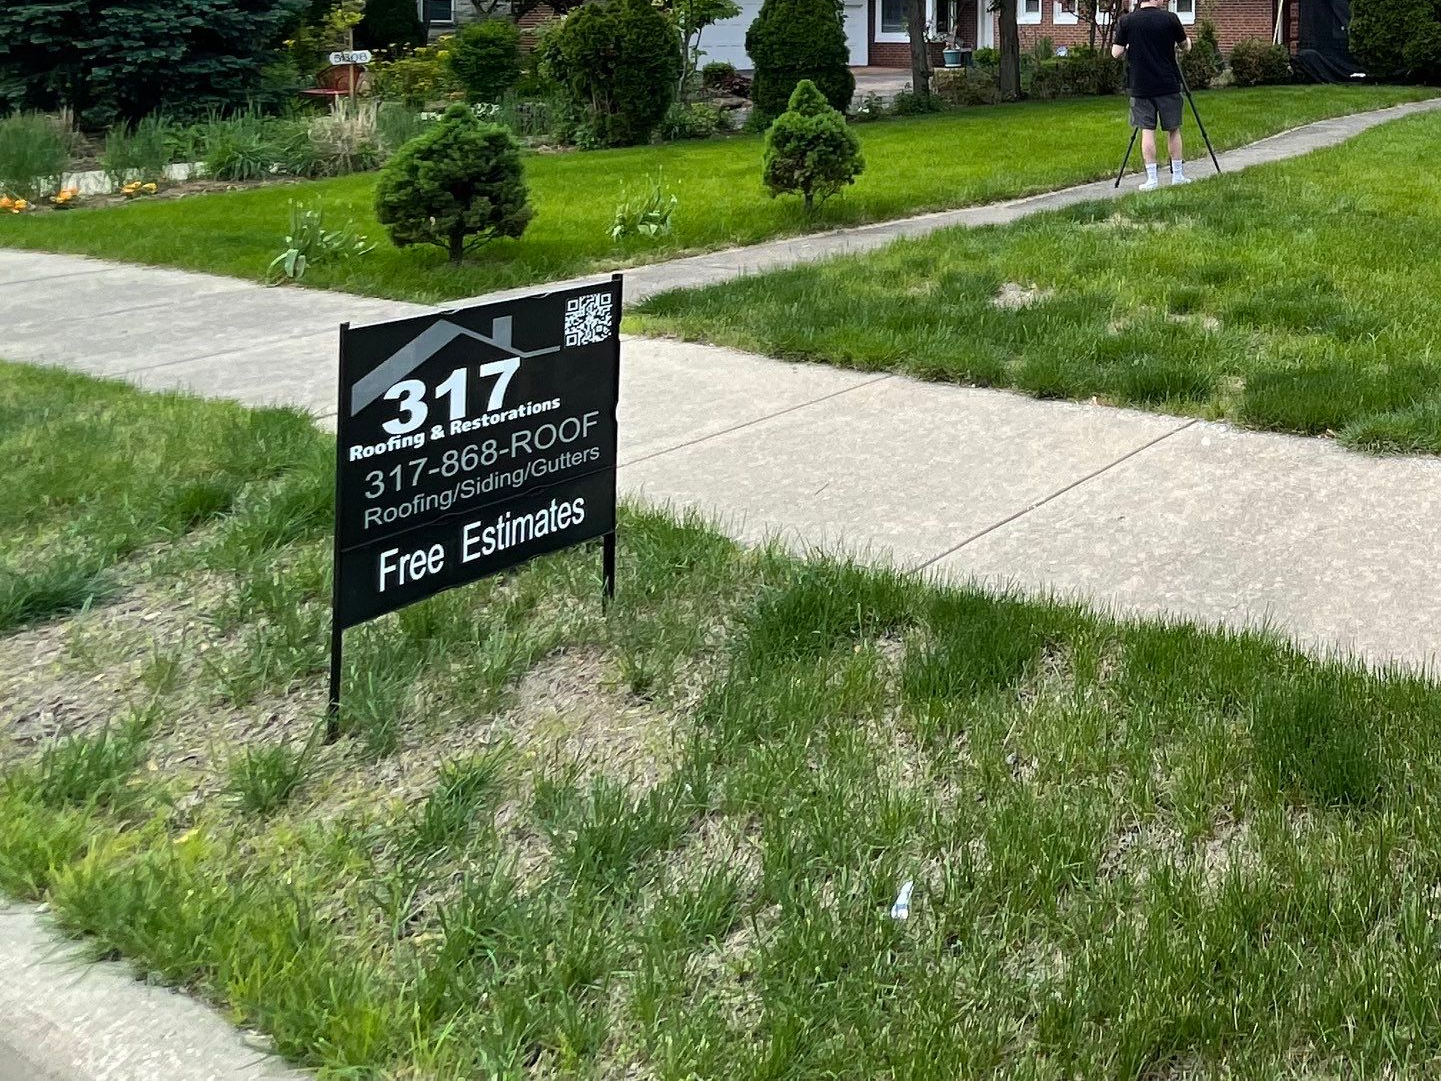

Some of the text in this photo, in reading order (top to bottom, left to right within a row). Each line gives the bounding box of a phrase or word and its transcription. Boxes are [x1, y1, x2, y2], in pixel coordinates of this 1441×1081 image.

[349, 398, 561, 462] Roofing & Restorations
[382, 357, 520, 435] 317
[364, 410, 599, 499] 317-868-ROOF
[364, 446, 600, 529] Roofing/Siding/Gutters
[379, 497, 585, 593] Free Estimates
